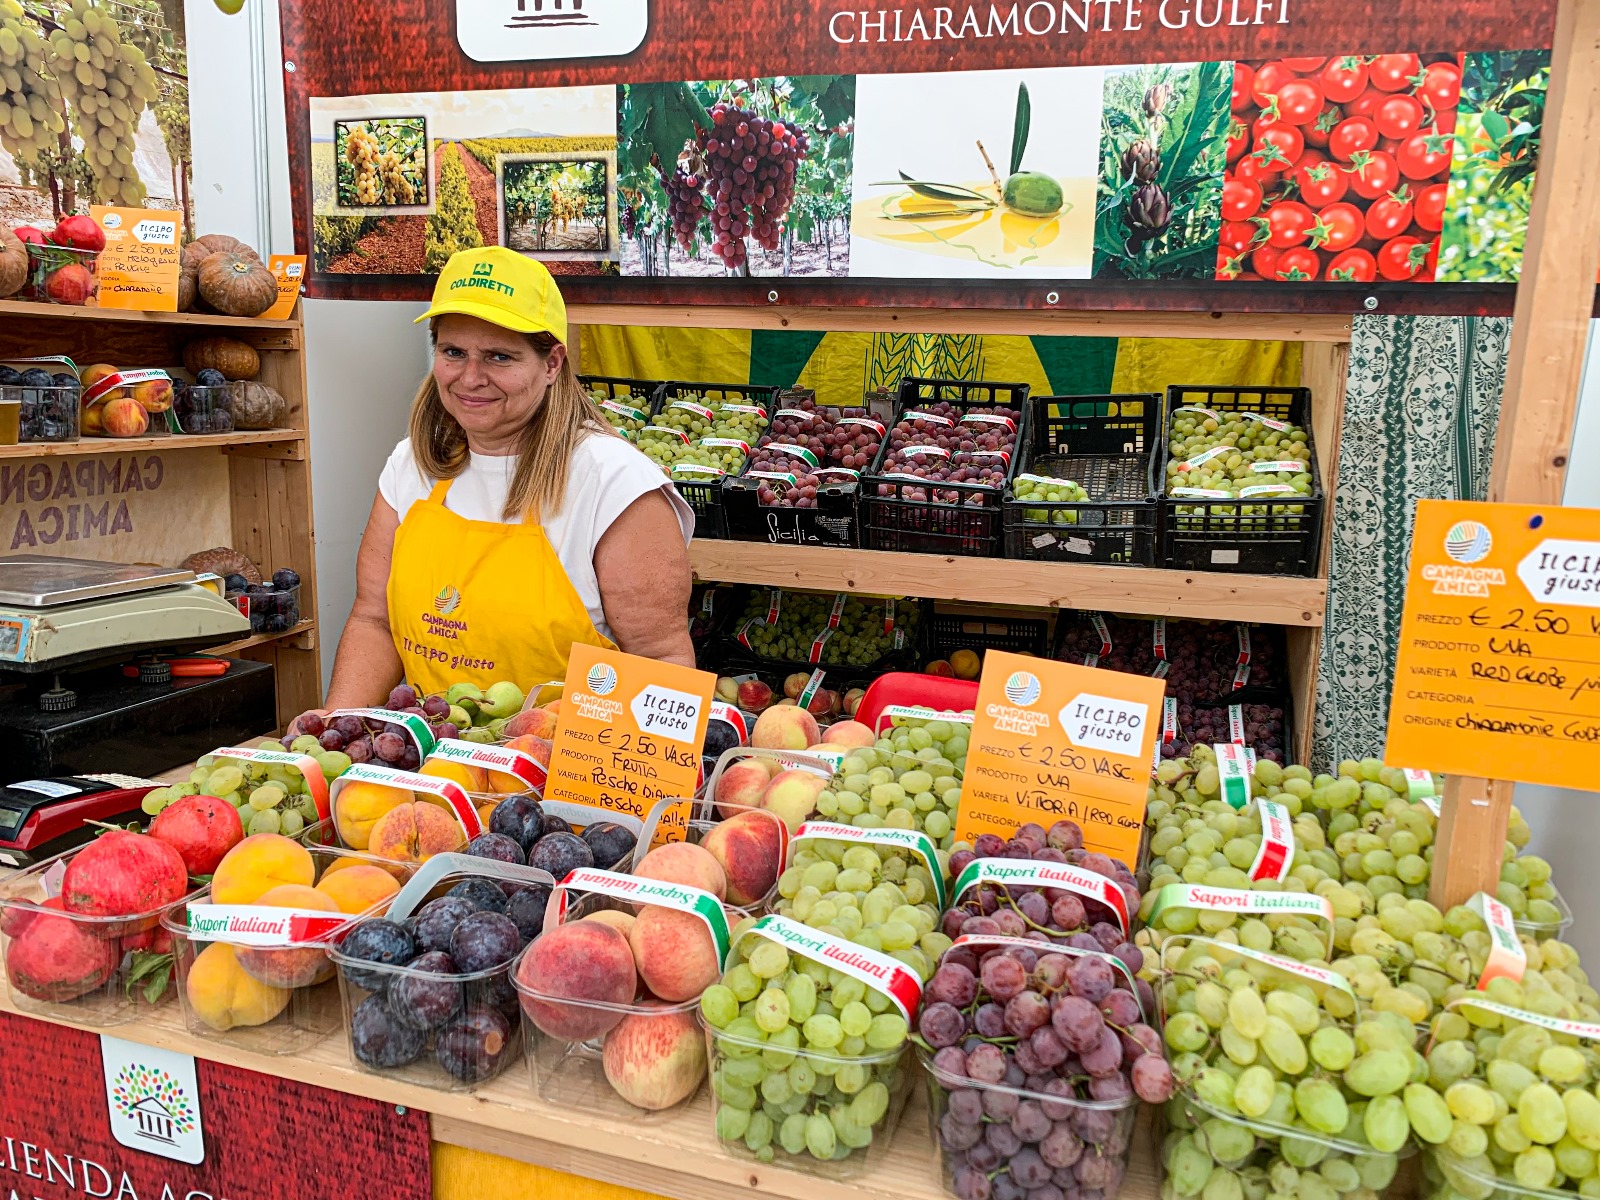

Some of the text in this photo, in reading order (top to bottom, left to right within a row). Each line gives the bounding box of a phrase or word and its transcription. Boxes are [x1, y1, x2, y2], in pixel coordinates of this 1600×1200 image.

[828, 0, 1291, 43] CHIARAMONTE GULFI
[450, 278, 514, 297] COLDIRETTI
[767, 512, 820, 544] Sicilia
[1422, 565, 1506, 584] CAMPAGNA
[1544, 573, 1600, 595] giust
[1433, 581, 1490, 598] AMICA
[422, 613, 468, 632] CAMPAGNA
[1416, 614, 1462, 626] PREZZO
[1468, 607, 1491, 626] €
[1501, 608, 1569, 634] 2.50
[427, 625, 458, 640] AMICA
[1413, 639, 1480, 653] PRODOTTO
[414, 643, 449, 663] CIBO
[451, 655, 495, 670] giusto
[1409, 666, 1457, 678] VARIETÀ
[571, 692, 623, 715] CAMPAGNA
[1407, 690, 1475, 705] CATEGORIA
[577, 705, 613, 722] AMICA
[658, 698, 696, 718] CIBO
[986, 704, 1050, 727] CAMPAGNA
[1094, 707, 1141, 728] CIBO
[645, 711, 688, 730] giusto
[994, 718, 1038, 736] AMICA
[1403, 714, 1452, 728] ORIGINE
[564, 729, 594, 742] PREZZO
[598, 728, 613, 745] €
[619, 734, 657, 756] 2.50
[1078, 724, 1132, 742] giusto
[438, 743, 515, 767] Sapori italiani
[560, 748, 604, 765] PRODOTTO
[980, 745, 1016, 759] PREZZO
[1018, 742, 1032, 757] €
[1039, 746, 1086, 770] 2.50
[350, 766, 443, 790] Sapori italiani
[557, 768, 588, 783] VARIETÀ
[976, 766, 1028, 784] PRODOTTO
[553, 788, 597, 805] CATEGORIA
[972, 789, 1010, 804] VARIETÀ
[969, 811, 1022, 829] CATEGORIA
[810, 825, 915, 843] Sapori italiani
[982, 863, 1100, 892] Sapori italiani
[574, 873, 696, 906] Sapori italiani
[1189, 888, 1321, 910] Sapori italiani
[192, 914, 286, 935] Sapori italiani
[768, 920, 892, 980] Sapori italiani
